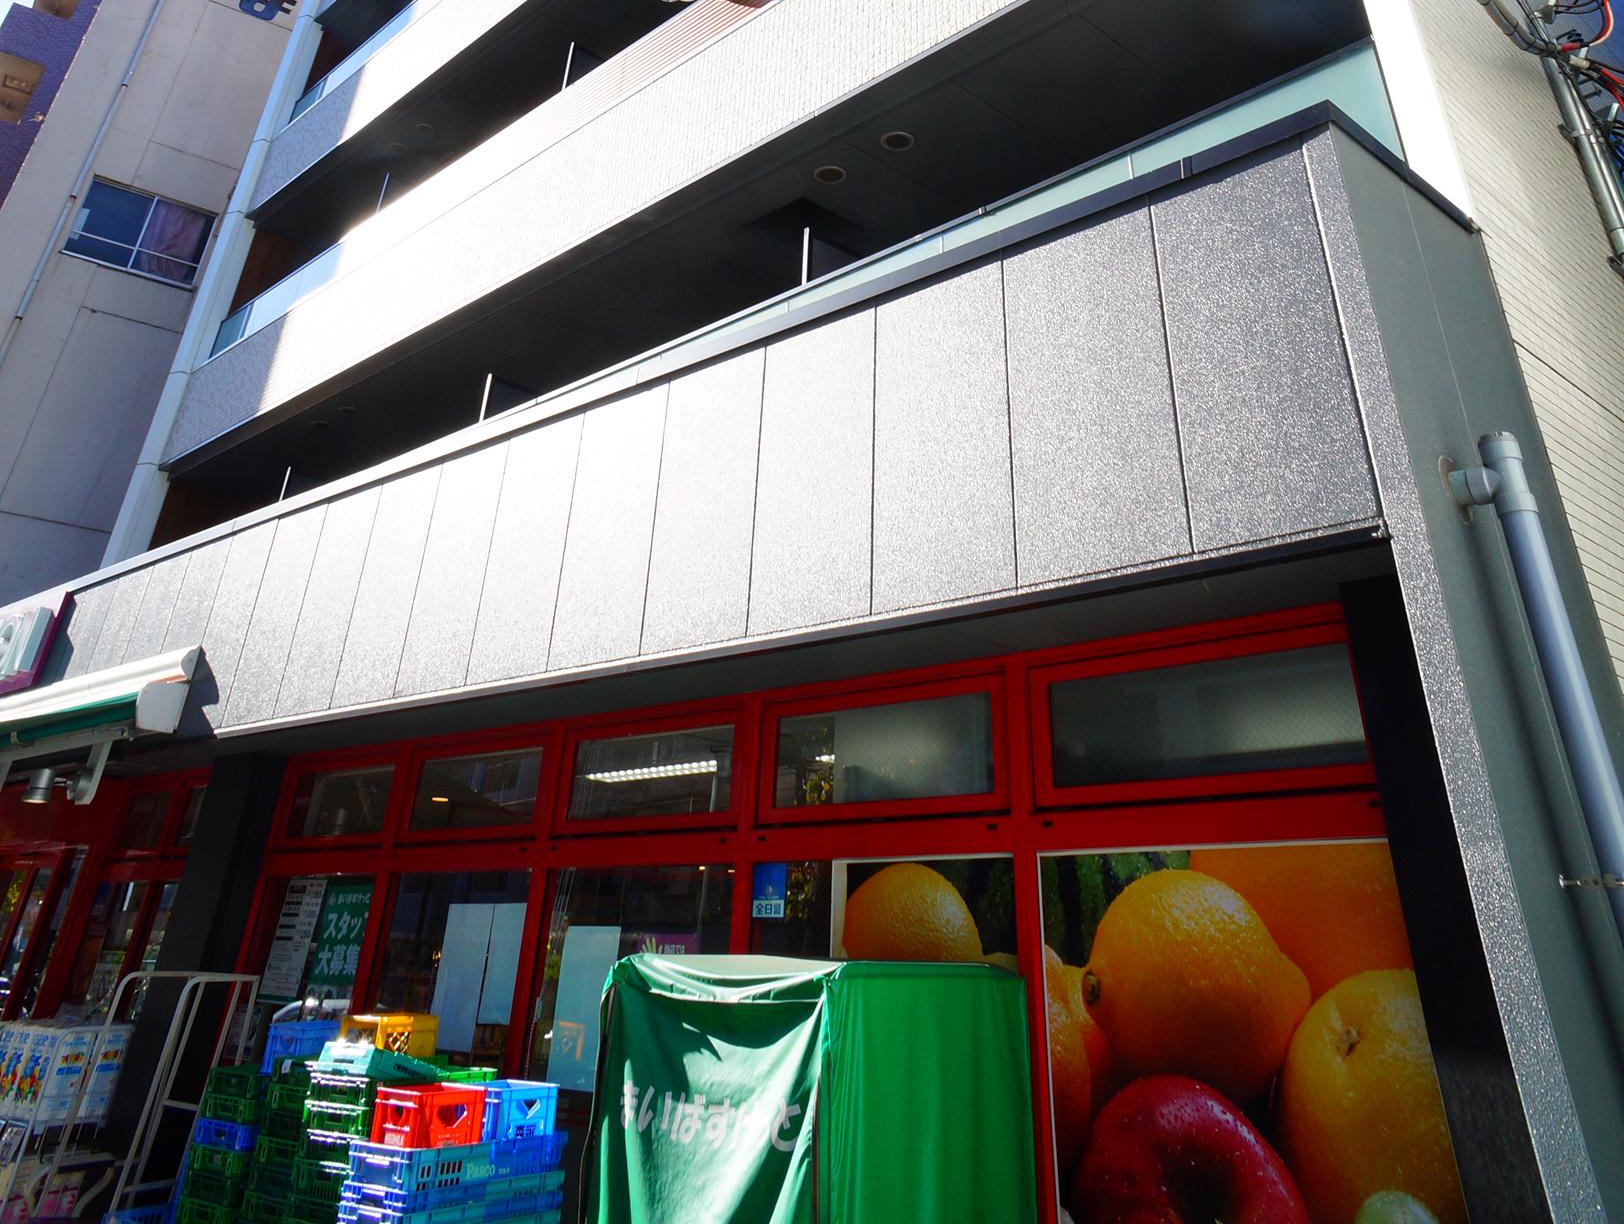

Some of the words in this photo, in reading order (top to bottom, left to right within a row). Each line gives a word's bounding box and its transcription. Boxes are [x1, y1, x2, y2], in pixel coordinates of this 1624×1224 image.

[323, 911, 369, 940] スタッ
[315, 943, 360, 975] 大募集
[620, 1080, 801, 1152] まいばすと
[466, 1163, 496, 1181] Pasco
